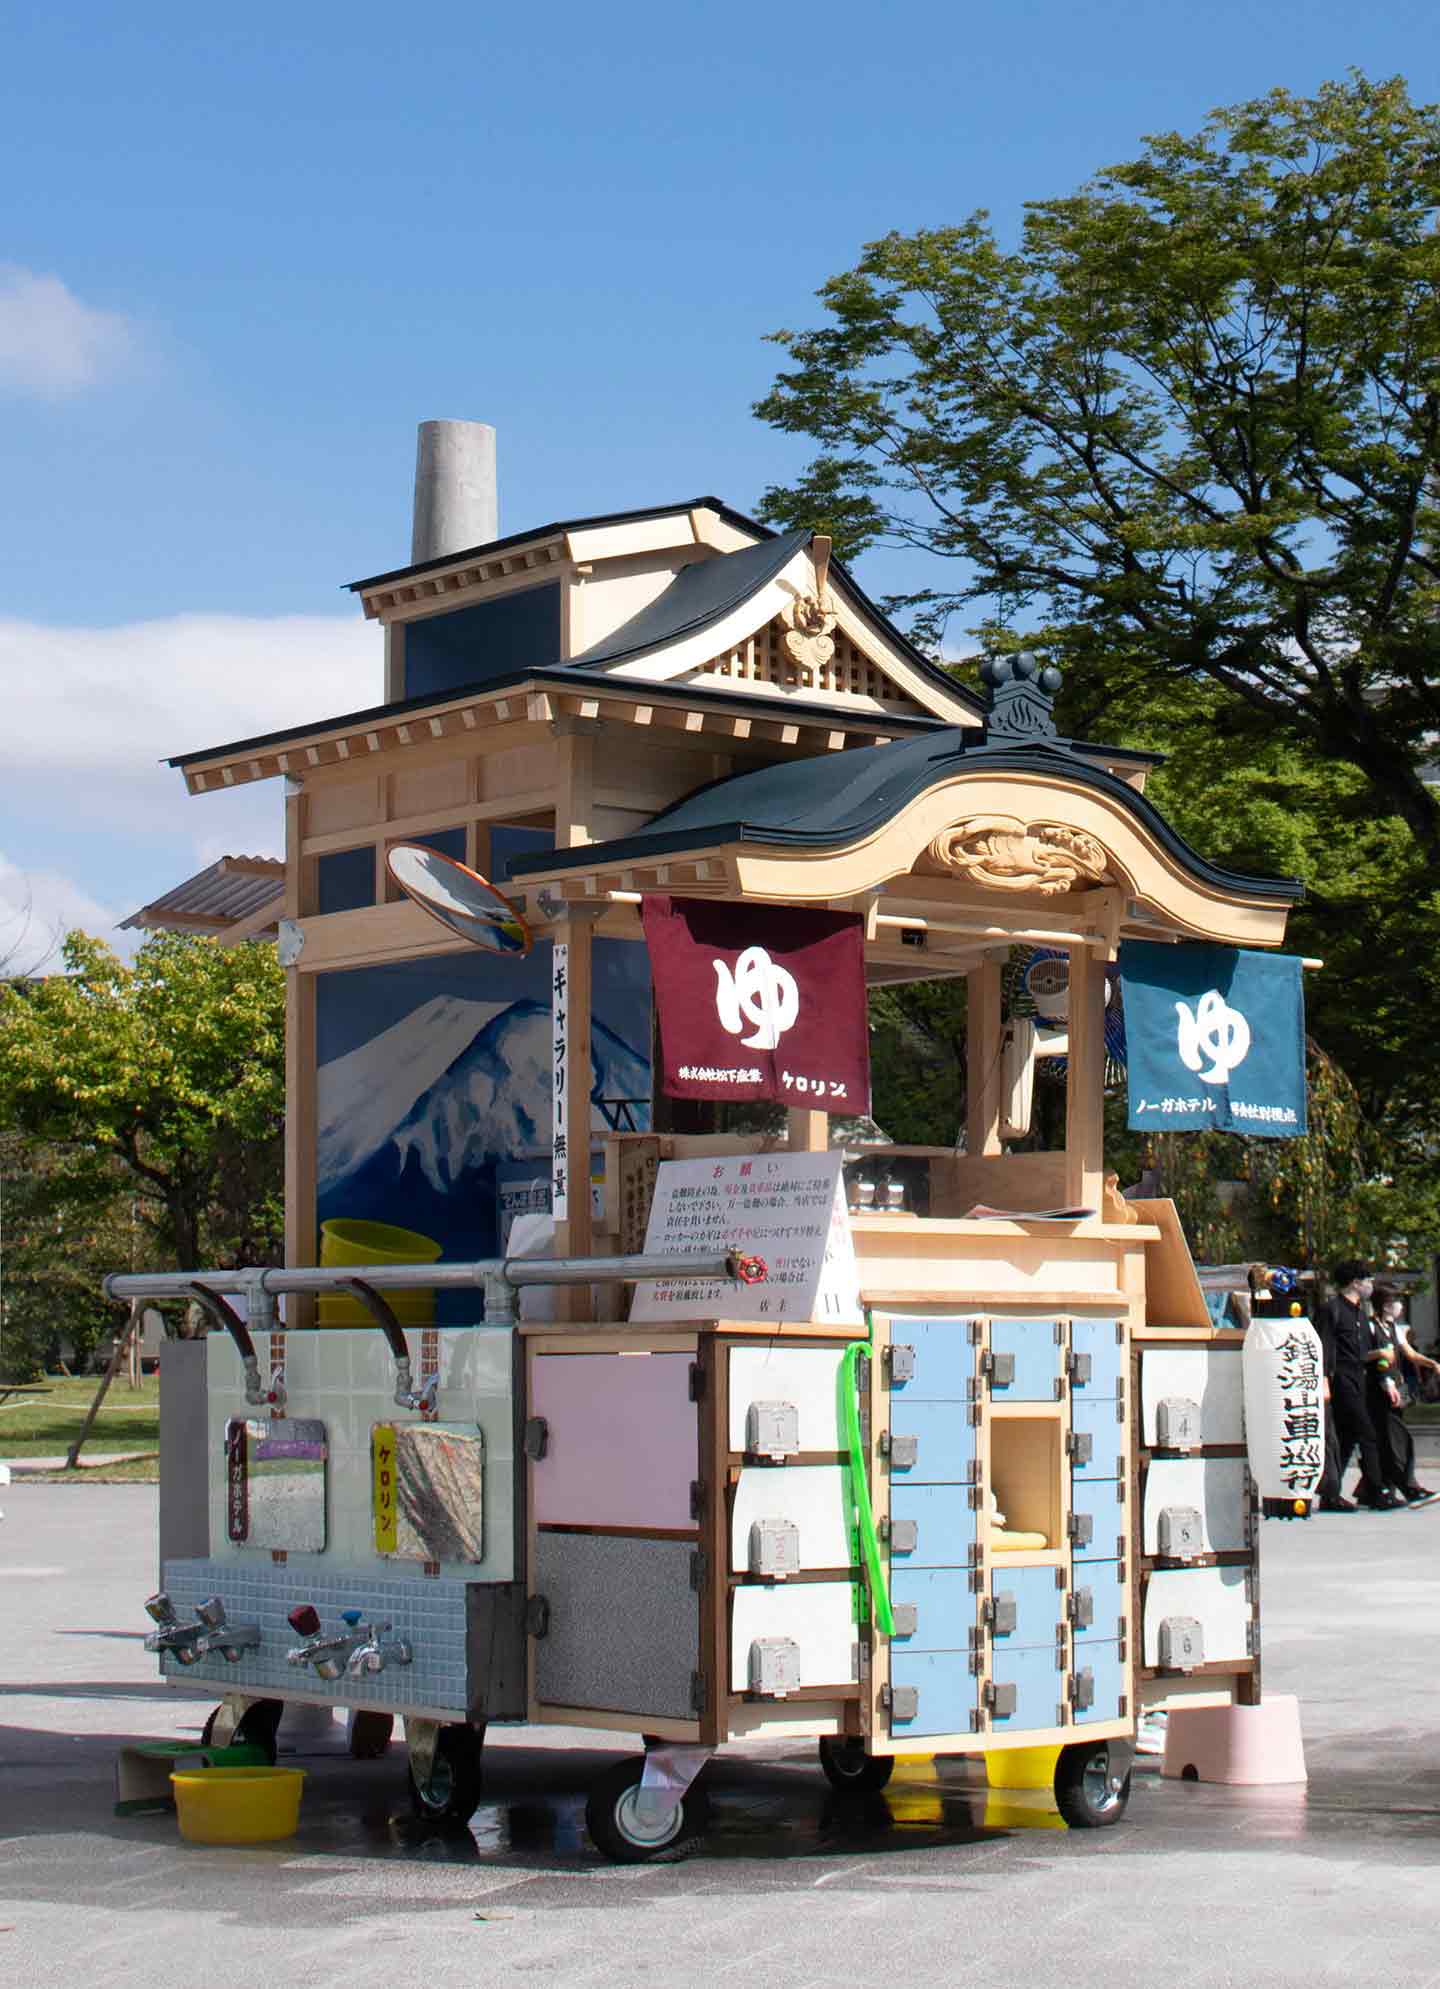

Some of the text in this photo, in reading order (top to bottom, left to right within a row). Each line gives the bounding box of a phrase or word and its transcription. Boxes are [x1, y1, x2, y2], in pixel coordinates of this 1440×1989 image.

[713, 946, 799, 1049] ゆ
[1175, 989, 1250, 1084] ゆ
[553, 968, 567, 1198] ギャラリー無量
[1136, 1097, 1216, 1114] ノーガホテル
[1179, 1415, 1191, 1438] 4
[1275, 1332, 1320, 1490] 銭湯山車巡行
[378, 1444, 391, 1531] ケロリン
